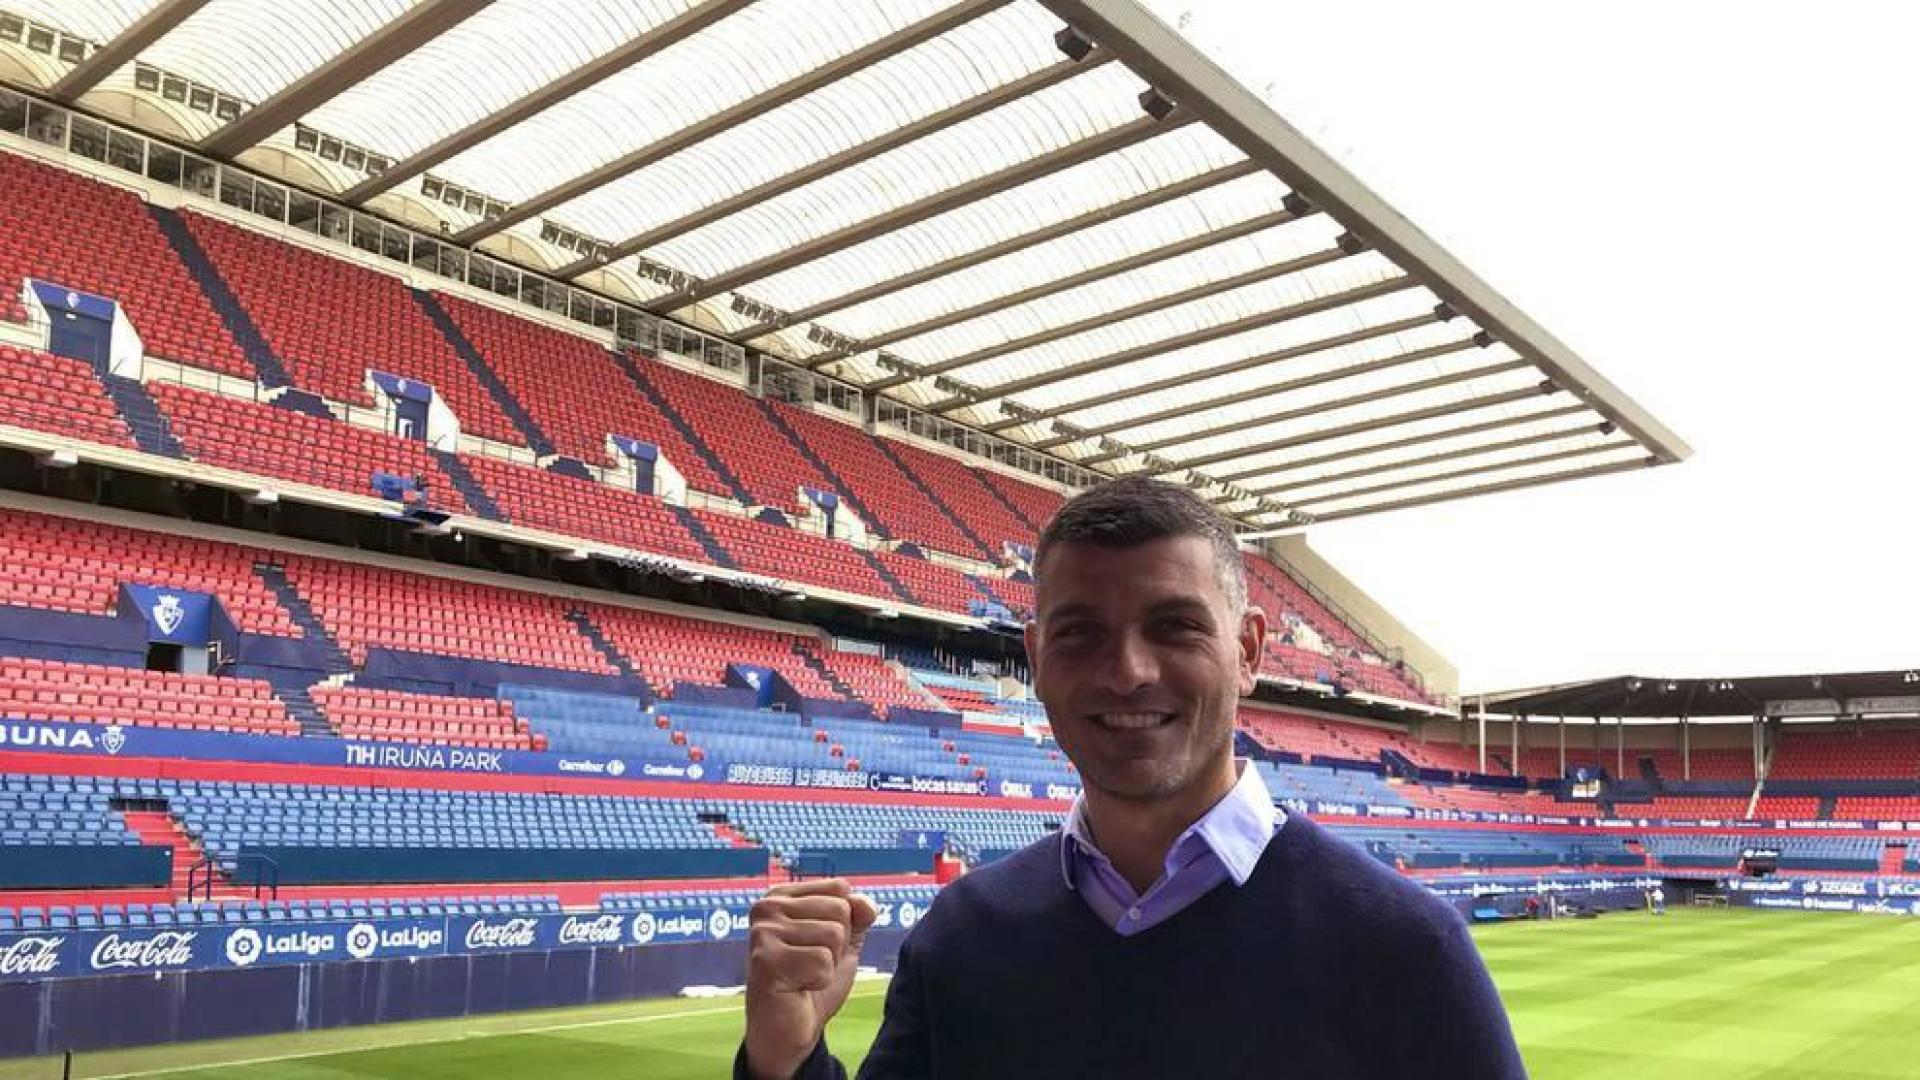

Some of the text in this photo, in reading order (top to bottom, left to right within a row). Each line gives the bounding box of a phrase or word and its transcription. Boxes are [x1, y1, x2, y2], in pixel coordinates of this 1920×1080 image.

[379, 746, 445, 769] IRUÑA
[450, 750, 502, 771] PARK
[657, 915, 703, 935] LaLiga
[266, 931, 334, 954] LaLiga
[381, 926, 442, 948] LaLiga
